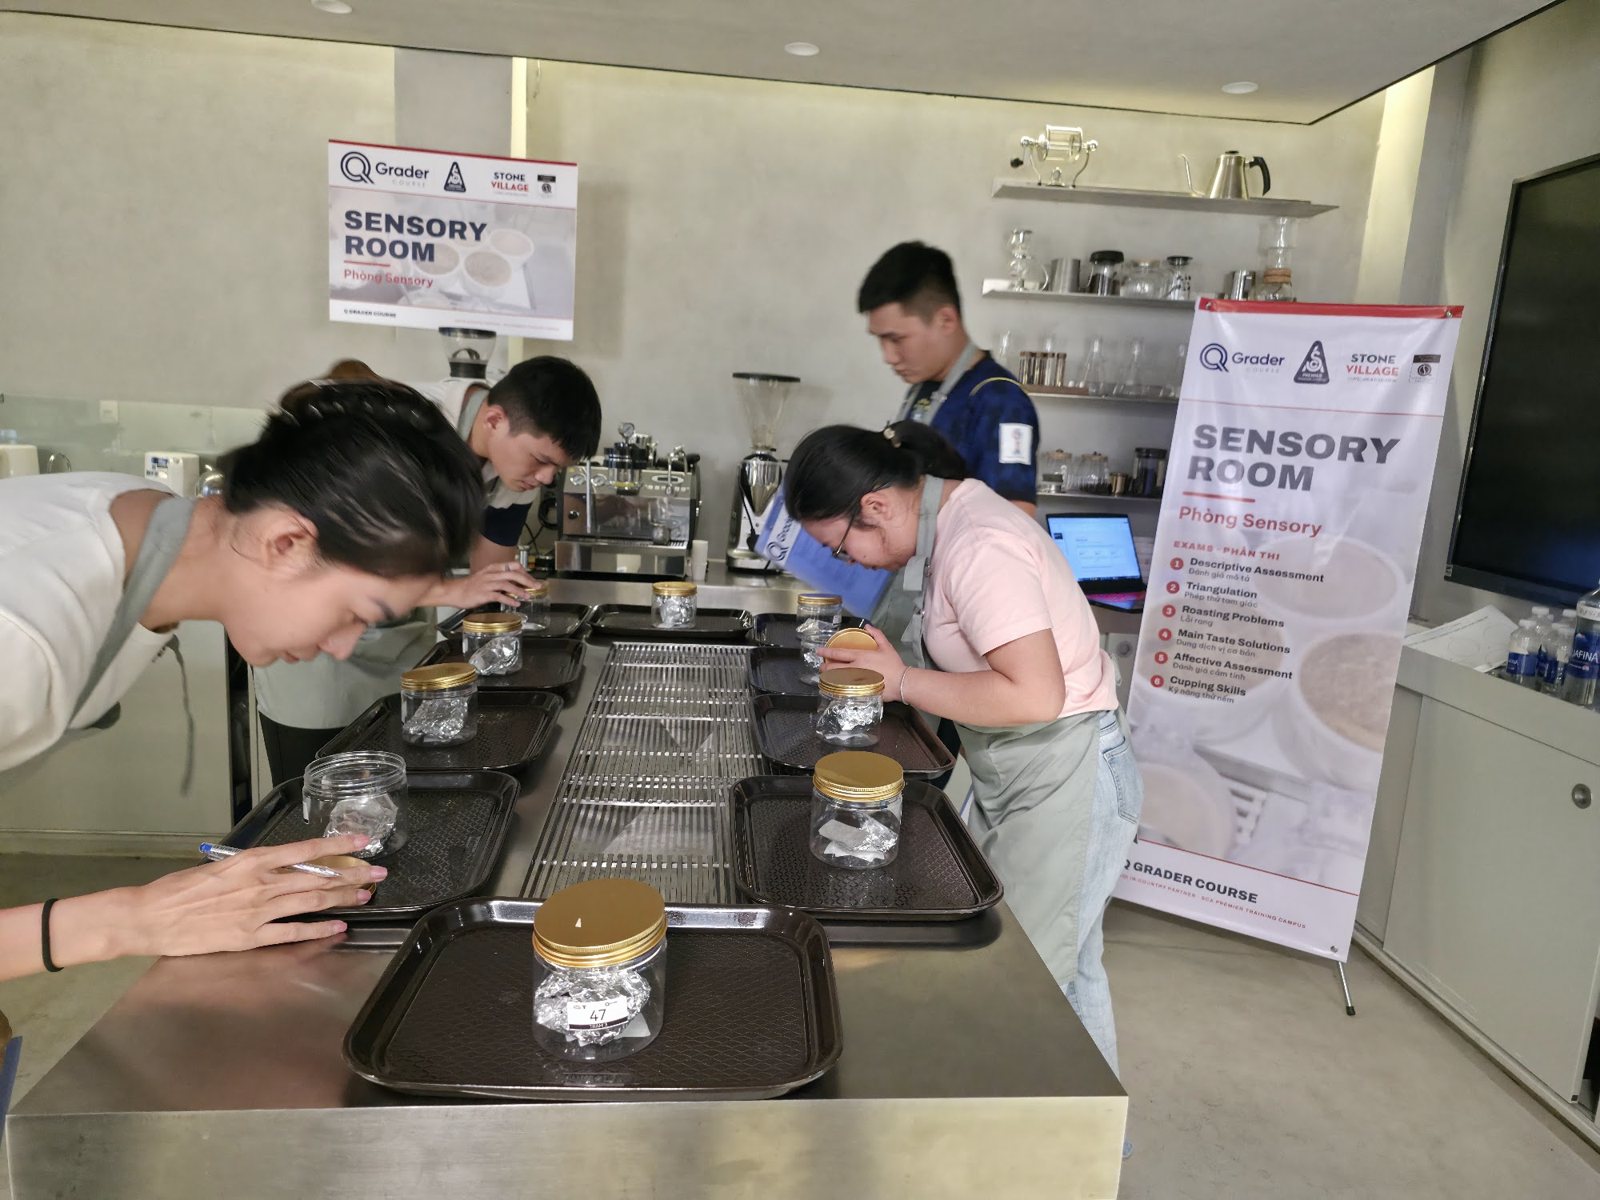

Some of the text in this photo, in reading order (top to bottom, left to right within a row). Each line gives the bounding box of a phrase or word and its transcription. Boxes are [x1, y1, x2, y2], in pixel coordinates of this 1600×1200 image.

[341, 152, 374, 184] Q
[376, 162, 429, 179] Grader
[494, 172, 525, 182] STONE
[491, 182, 528, 192] VILLAGE
[345, 210, 487, 241] SENSORY
[345, 236, 434, 262] ROOM
[344, 269, 433, 288] Phòng Sensory
[1200, 343, 1285, 372] Q Grader
[1351, 354, 1396, 364] STONE
[1346, 365, 1398, 376] VILLAGE
[1193, 424, 1400, 464] SENSORY
[1188, 456, 1314, 491] ROOM
[1179, 506, 1322, 538] Phòng Sensory
[1174, 541, 1214, 552] EXAMS
[1260, 552, 1280, 560] THI
[1190, 558, 1252, 573] Descriptive
[1254, 566, 1324, 582] Assessment
[1186, 582, 1258, 598] Triangulation
[1182, 605, 1230, 620] Roasting
[1232, 612, 1284, 628] Problems
[1178, 628, 1204, 640] Main
[1207, 633, 1236, 645] Taste
[1238, 638, 1290, 654] Solutions
[1174, 652, 1222, 667] Affective
[1224, 661, 1292, 680] Assessment
[1170, 676, 1214, 692] Cupping
[1216, 683, 1246, 696] Skills
[1133, 862, 1192, 886] GRADER
[1195, 878, 1258, 904] COURSE
[1278, 917, 1306, 929] CAMPUS
[590, 1008, 606, 1021] 47
